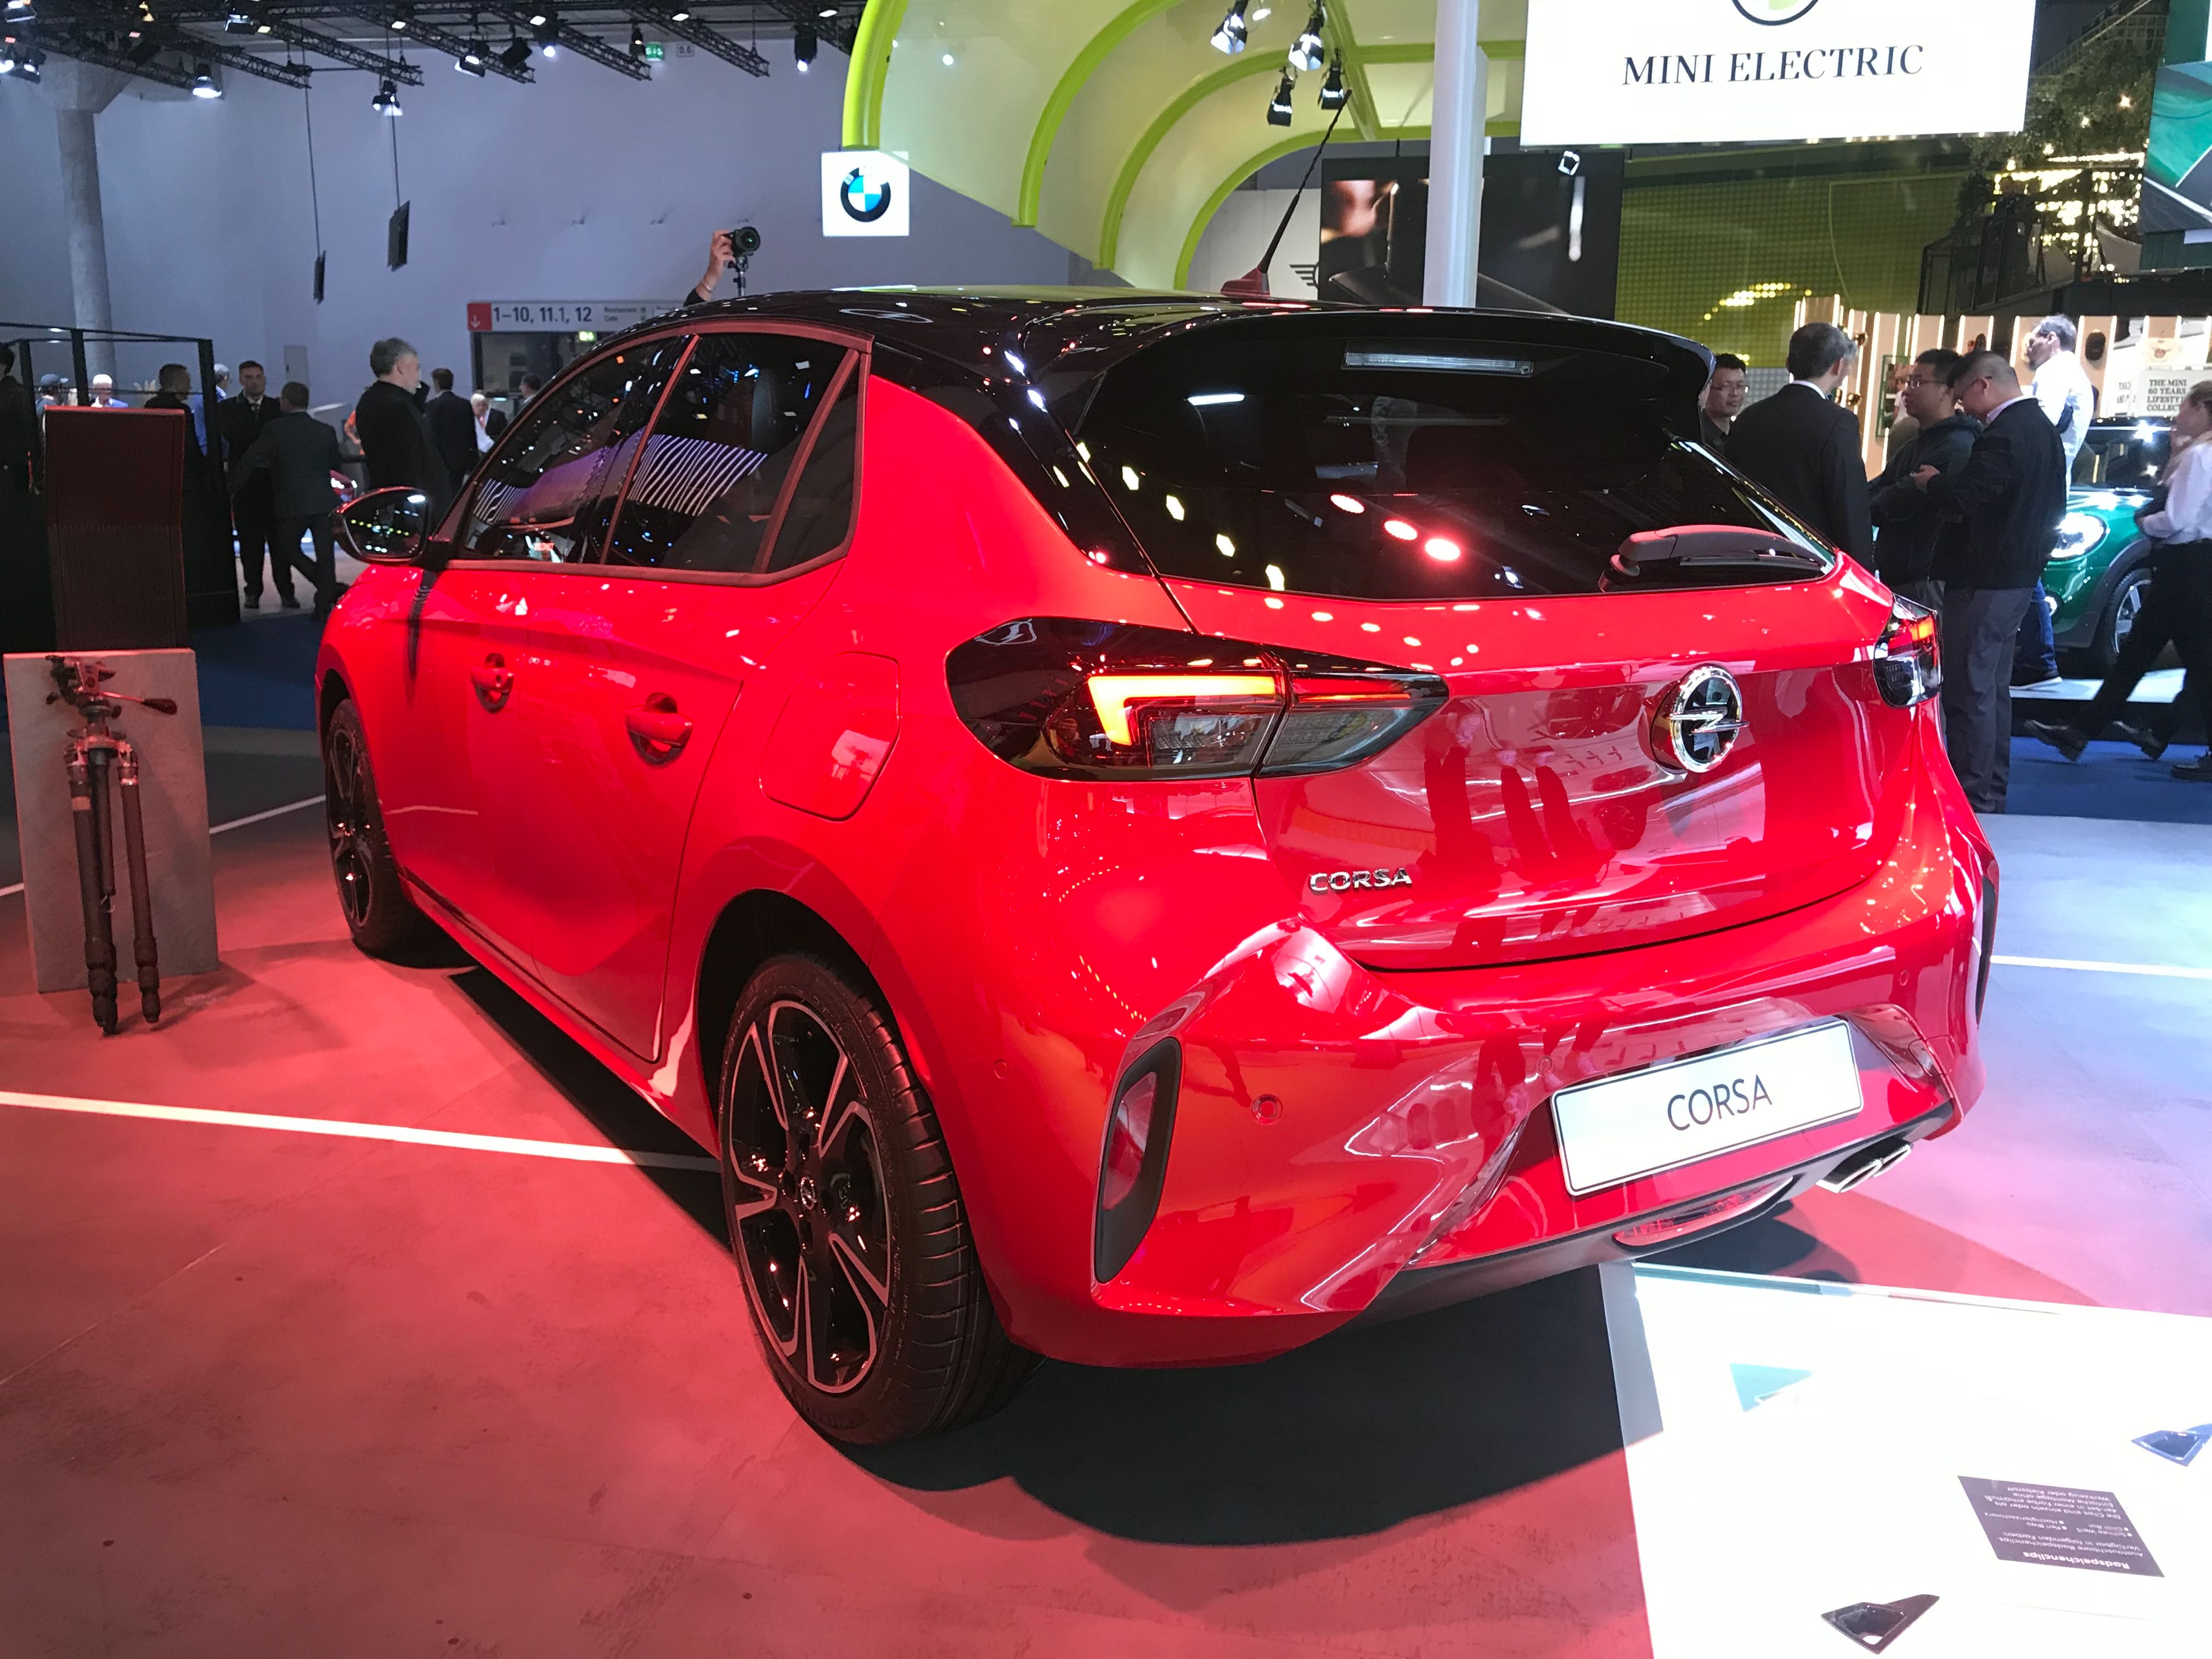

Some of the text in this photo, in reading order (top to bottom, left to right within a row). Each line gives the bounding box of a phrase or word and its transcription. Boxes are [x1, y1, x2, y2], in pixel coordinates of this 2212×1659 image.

[1622, 44, 1923, 86] MINI ELECTRIC
[539, 306, 569, 324] 11.1,
[575, 306, 592, 323] 12
[1310, 867, 1412, 891] CORSA
[1667, 1074, 1773, 1131] CORSA
[2036, 1494, 2074, 1503] Montage
[2068, 1492, 2109, 1500] Werkzeug
[1984, 1512, 2057, 1524] Hochglanzschwarz
[2038, 1534, 2082, 1544] folgenden
[2078, 1546, 2143, 1556] Austauschbare
[2095, 1541, 2140, 1550] Verfügbar
[2023, 1551, 2130, 1568] Radspeichenclips
